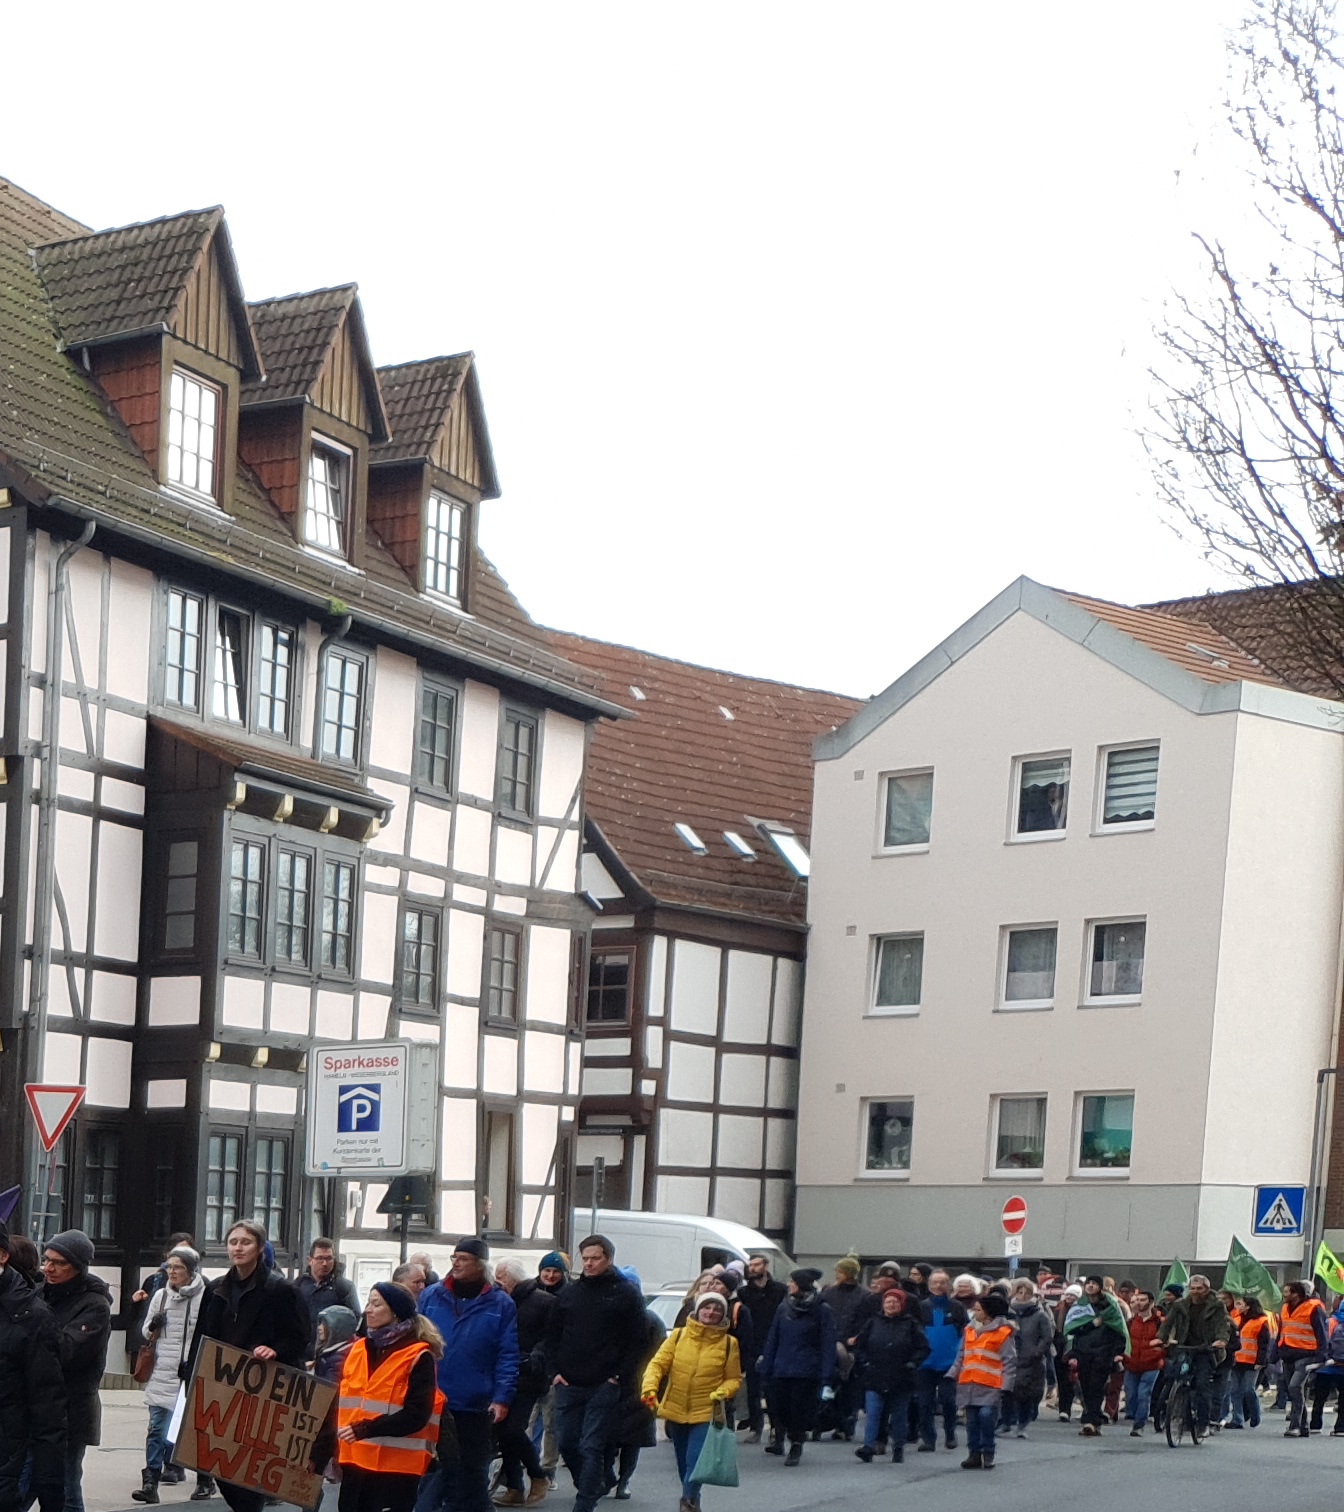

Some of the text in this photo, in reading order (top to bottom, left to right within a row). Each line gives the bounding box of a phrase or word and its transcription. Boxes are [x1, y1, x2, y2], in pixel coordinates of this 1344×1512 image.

[323, 1055, 400, 1072] Sparkasse
[352, 1099, 372, 1131] P
[215, 1345, 317, 1412] WO EIN
[194, 1376, 290, 1456] WILLE
[196, 1429, 288, 1494] WEG
